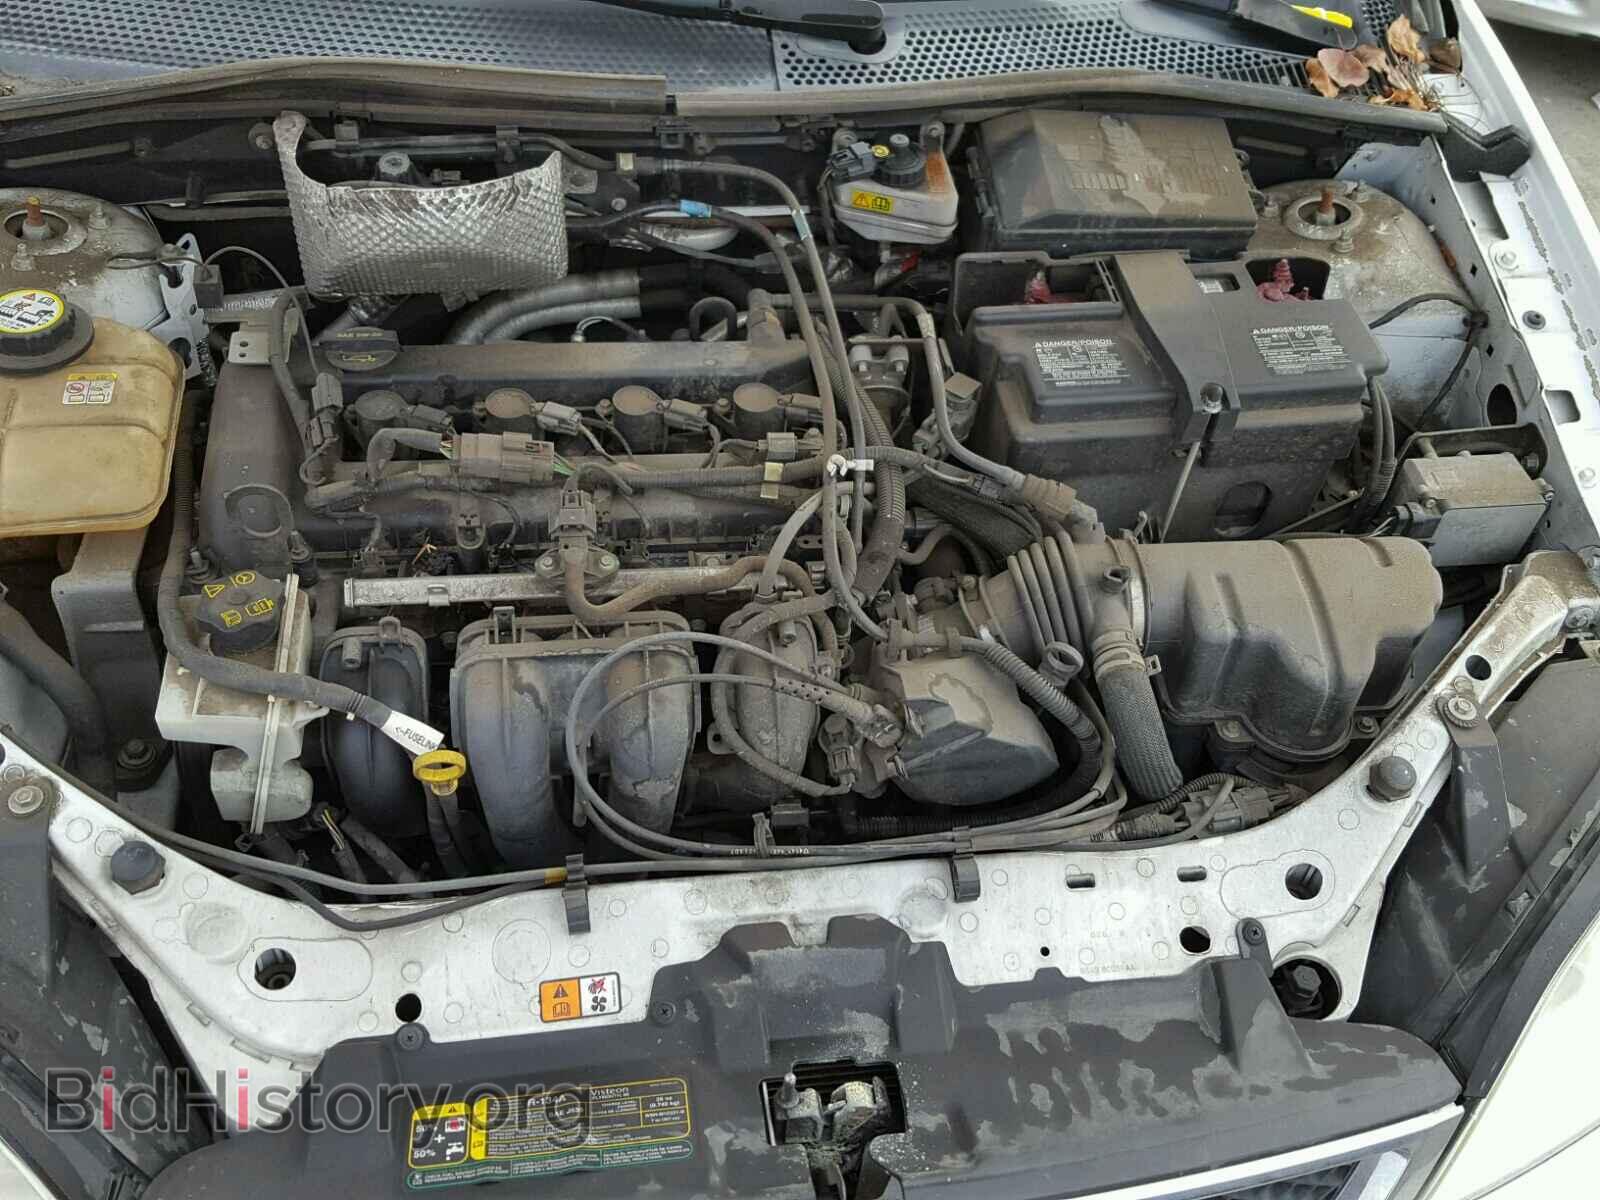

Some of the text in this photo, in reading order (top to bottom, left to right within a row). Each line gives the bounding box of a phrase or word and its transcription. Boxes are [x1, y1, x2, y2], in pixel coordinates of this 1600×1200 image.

[1042, 338, 1112, 347] DANGER/POISON
[590, 1086, 629, 1097] Visteon
[413, 1149, 437, 1159] 50%
